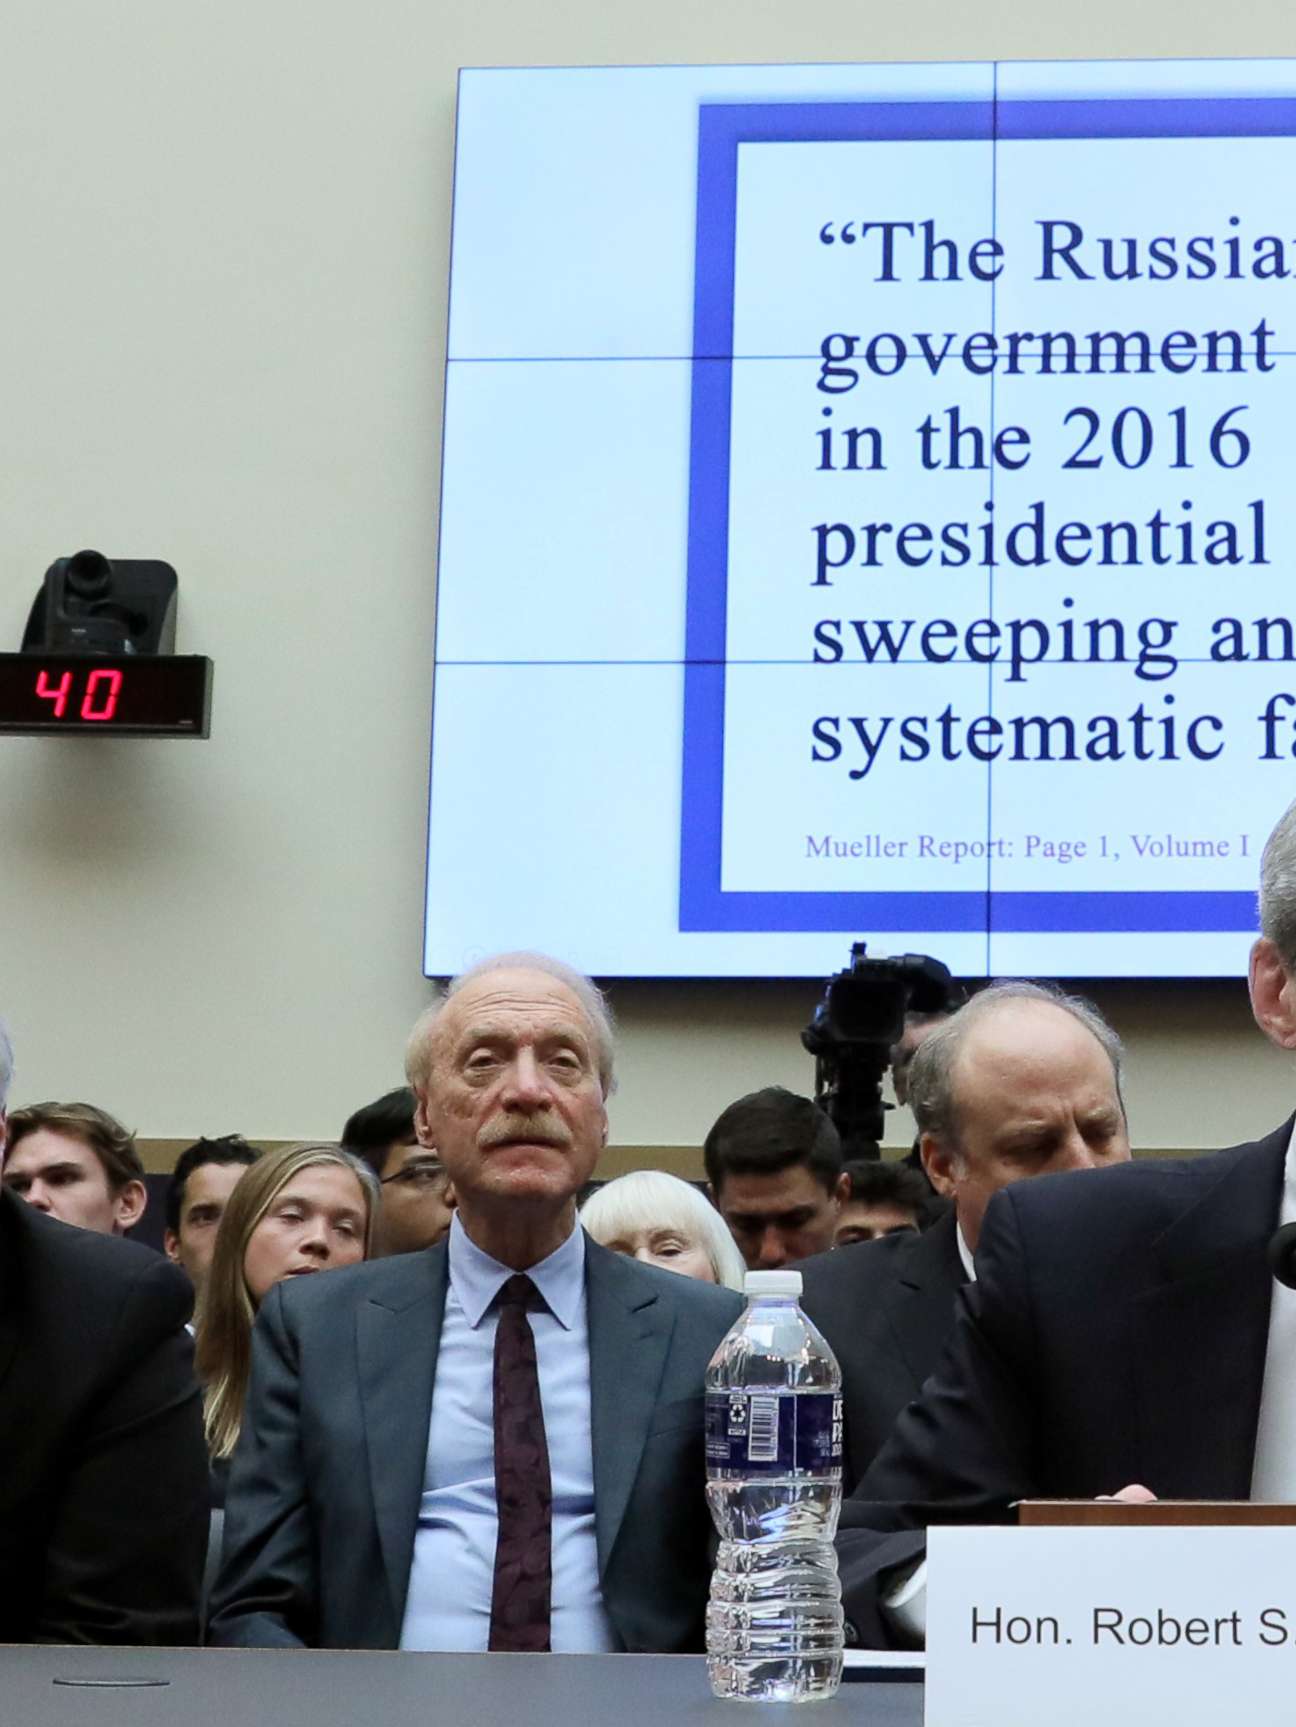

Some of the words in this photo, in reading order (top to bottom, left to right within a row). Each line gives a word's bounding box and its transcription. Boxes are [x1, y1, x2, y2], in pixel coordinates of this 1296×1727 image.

[820, 219, 1004, 282] “The
[816, 319, 1275, 394] government
[817, 407, 885, 470] in
[916, 406, 1031, 470] the
[1062, 406, 1250, 469] 2016
[811, 500, 1269, 586] presidential
[812, 597, 1179, 682] sweeping
[35, 669, 123, 721] 40
[812, 694, 1224, 780] systematic
[805, 834, 908, 858] Mueller
[918, 835, 1013, 865] Report:
[1025, 834, 1086, 864] Page
[1100, 834, 1120, 863] 1,
[1131, 834, 1230, 858] Volume
[1238, 835, 1250, 858] I
[971, 1607, 1072, 1645] Hon.
[1093, 1608, 1242, 1646] Robert
